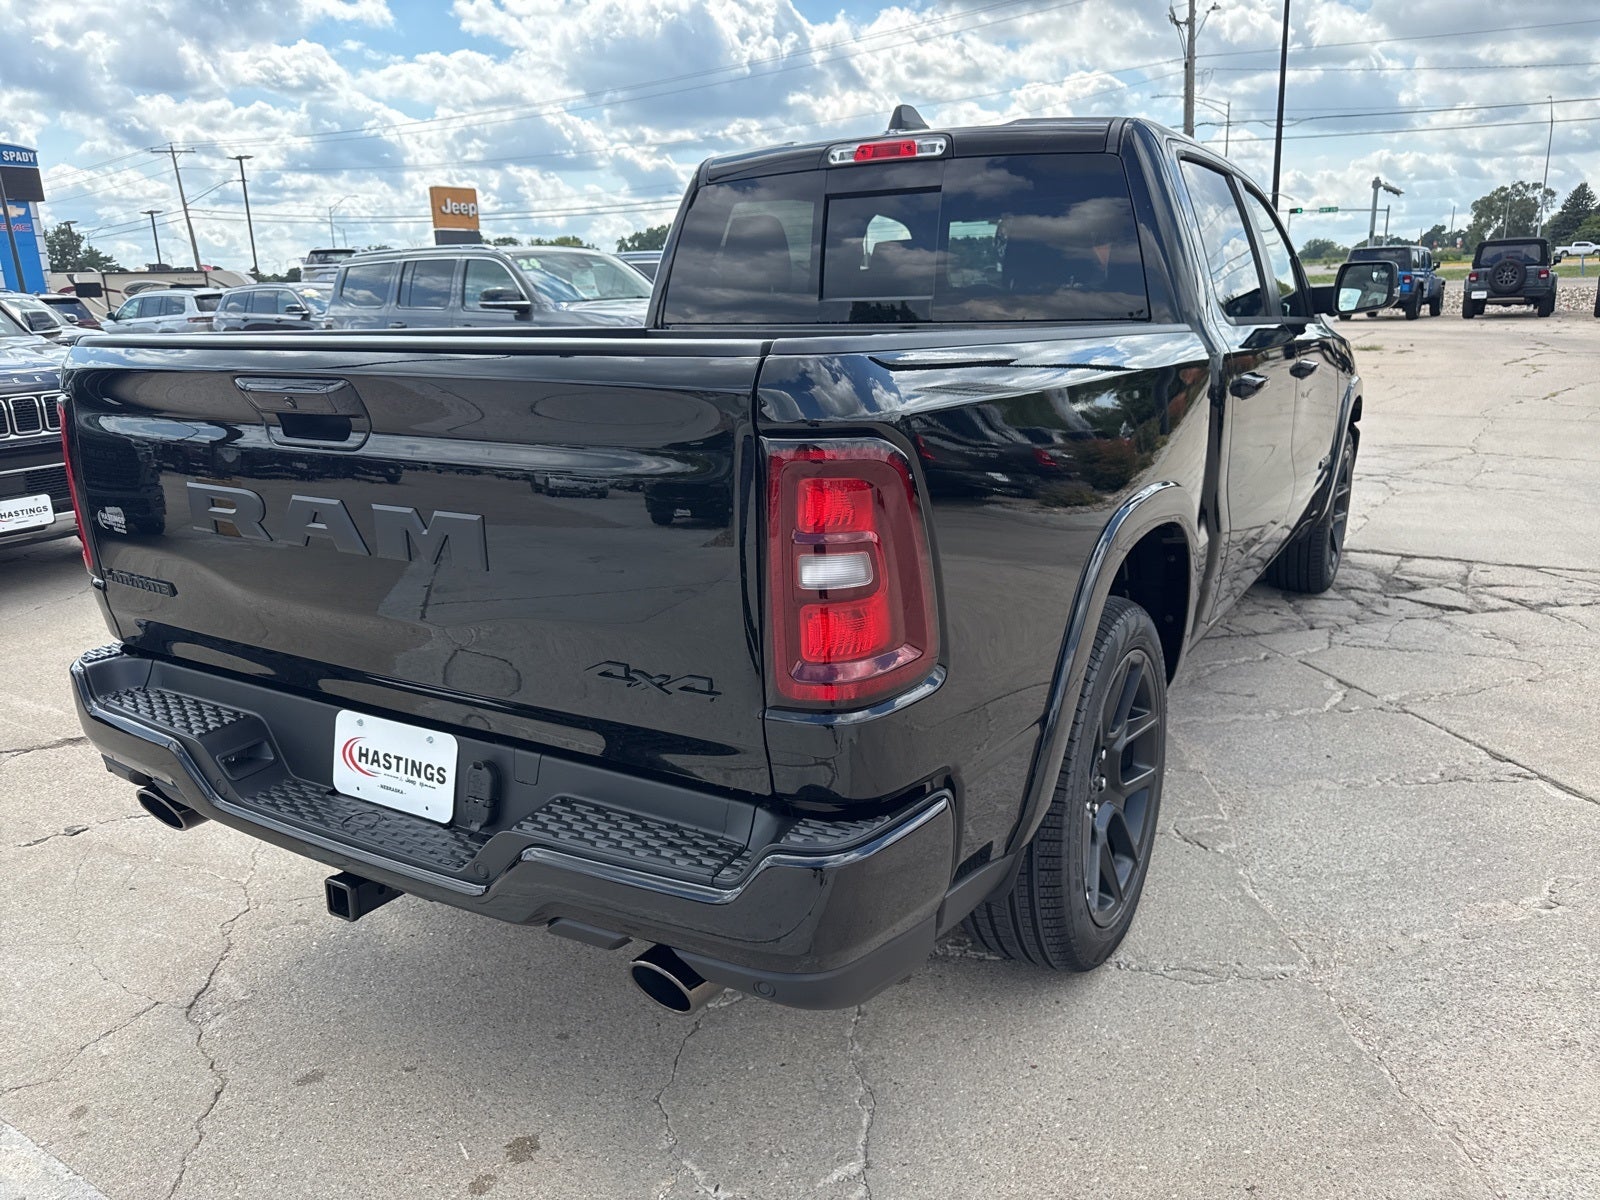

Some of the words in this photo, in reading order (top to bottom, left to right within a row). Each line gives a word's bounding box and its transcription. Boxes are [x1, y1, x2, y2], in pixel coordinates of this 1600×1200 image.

[2, 150, 34, 163] SPADY
[441, 197, 477, 218] Jeep
[0, 505, 48, 519] HASTINGS
[186, 481, 489, 572] RAM
[358, 746, 447, 785] HASTINGS
